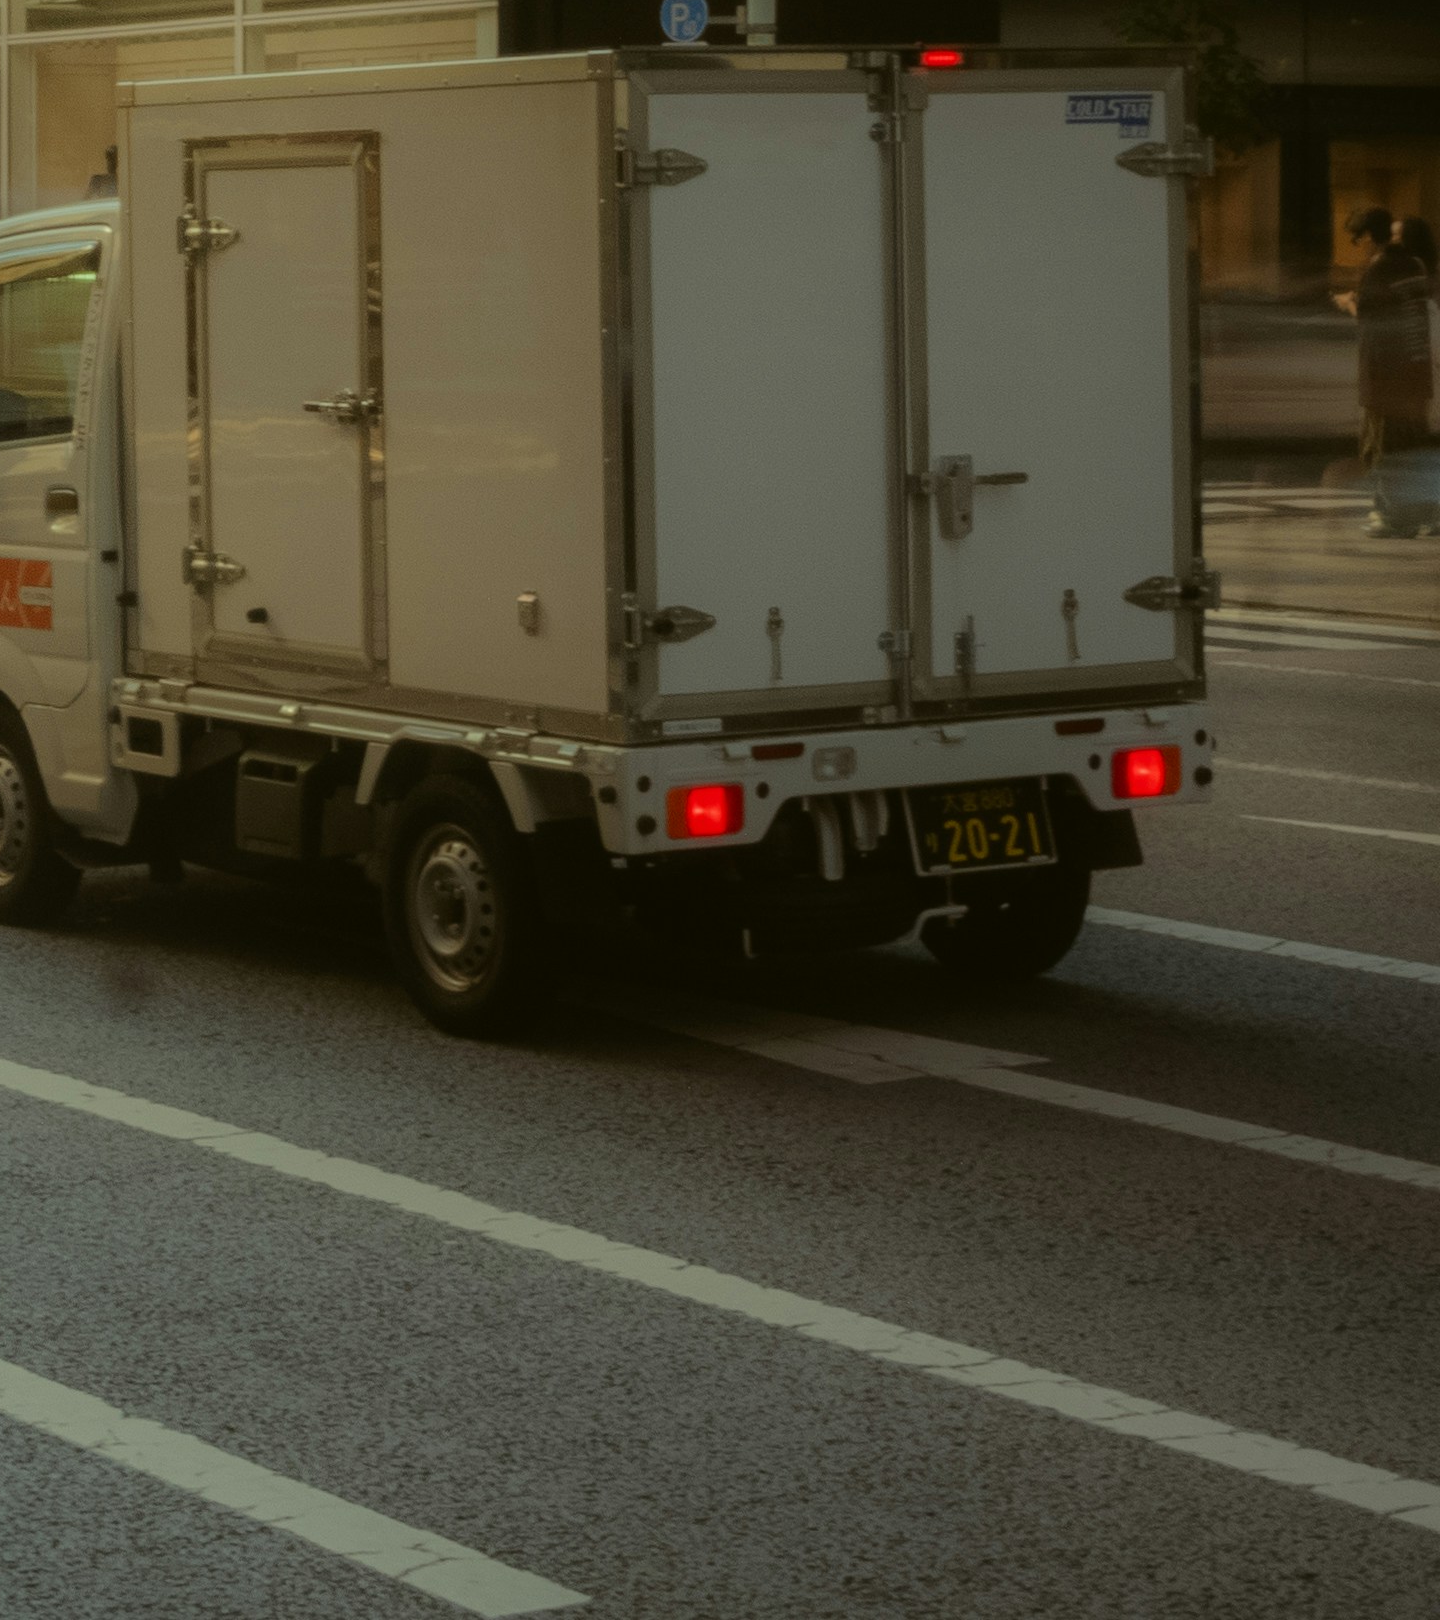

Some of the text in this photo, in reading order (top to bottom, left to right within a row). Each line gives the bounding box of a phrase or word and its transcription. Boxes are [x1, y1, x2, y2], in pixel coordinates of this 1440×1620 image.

[1067, 98, 1150, 118] COLD STAR
[943, 811, 1041, 863] 20-21
